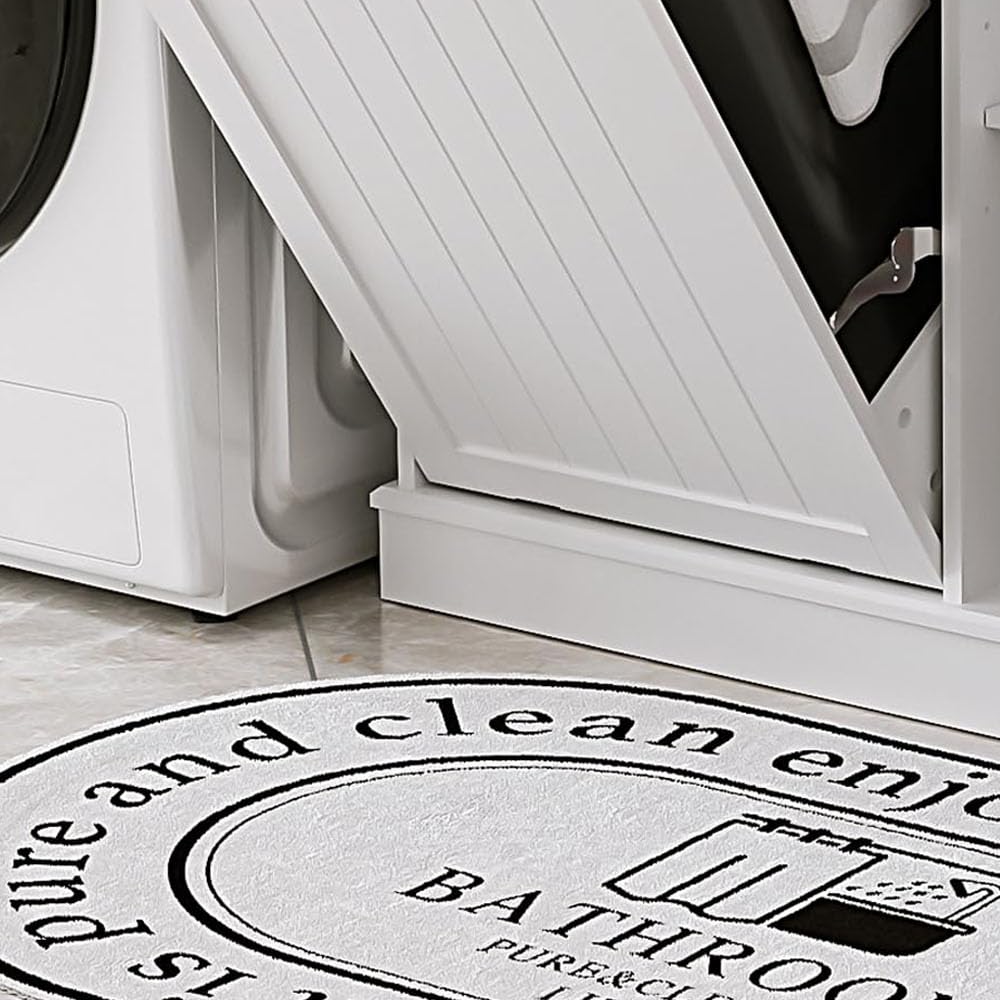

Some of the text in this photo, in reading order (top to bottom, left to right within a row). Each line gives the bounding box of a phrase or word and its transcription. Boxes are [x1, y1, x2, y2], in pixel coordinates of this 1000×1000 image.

[6, 818, 156, 951] pure
[83, 719, 316, 809] and
[355, 696, 738, 758] clean
[393, 866, 954, 1000] BATHROO
